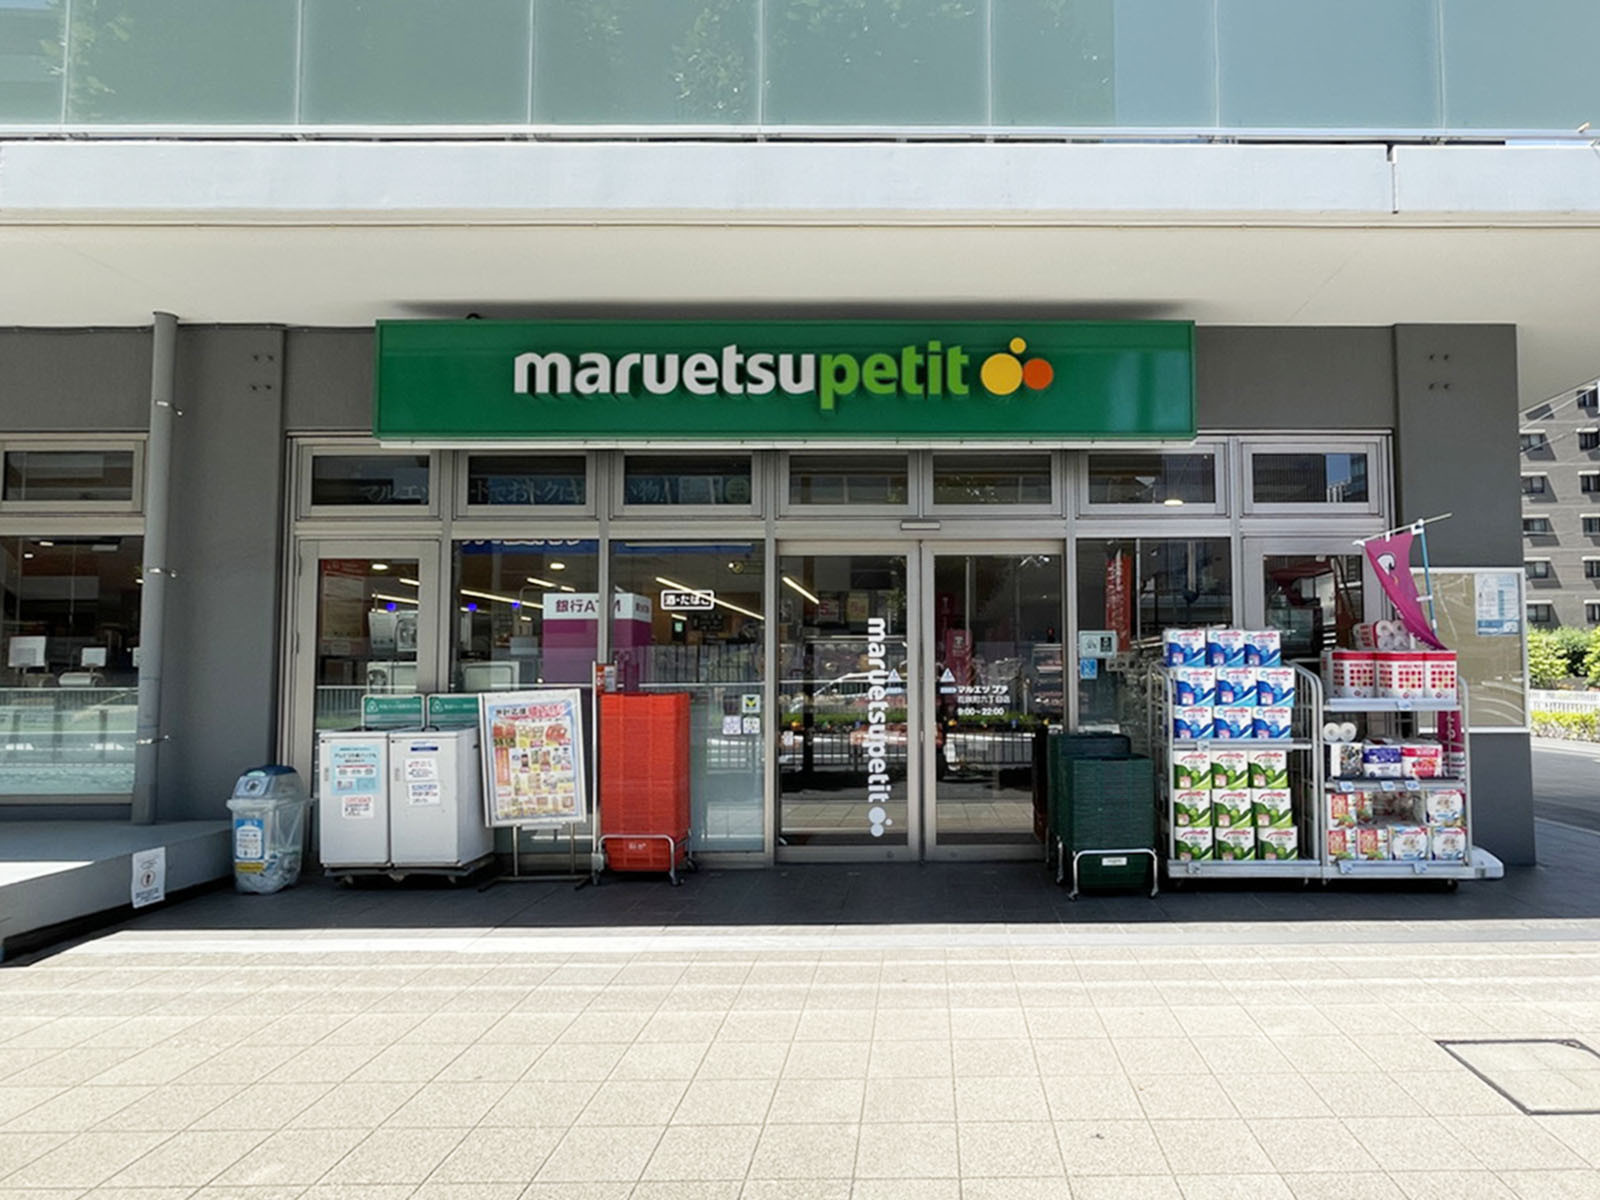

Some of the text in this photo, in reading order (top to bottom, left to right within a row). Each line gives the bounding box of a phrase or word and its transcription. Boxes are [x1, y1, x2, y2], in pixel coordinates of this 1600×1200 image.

[514, 341, 970, 409] maruetsupetit
[556, 599, 620, 613] 銀行AM
[868, 618, 891, 802] maruetsupetit
